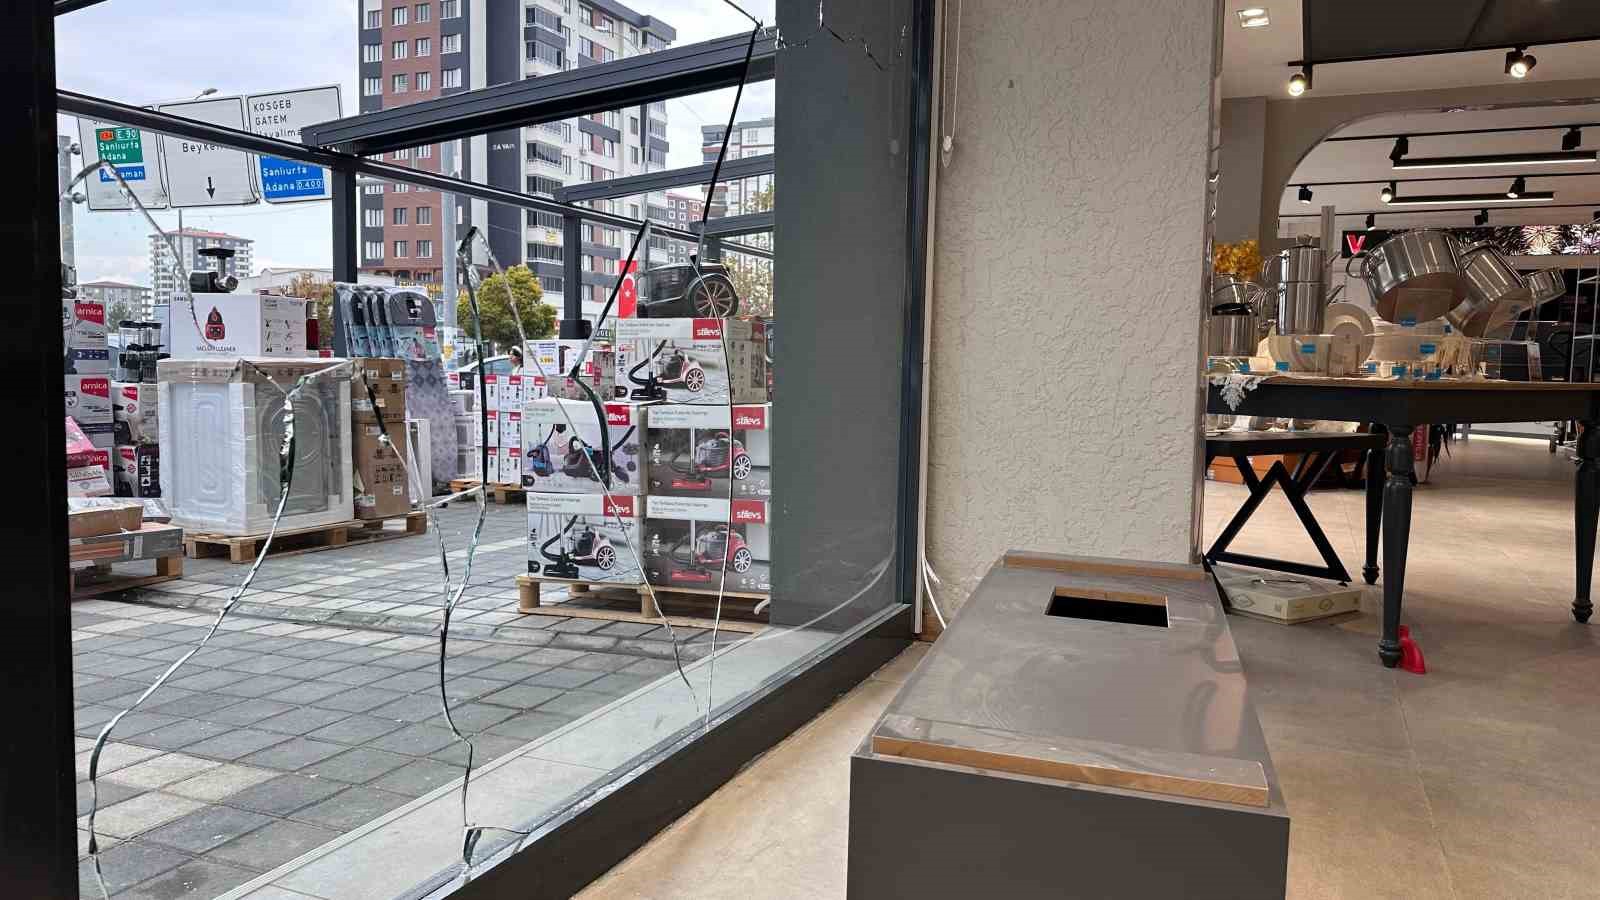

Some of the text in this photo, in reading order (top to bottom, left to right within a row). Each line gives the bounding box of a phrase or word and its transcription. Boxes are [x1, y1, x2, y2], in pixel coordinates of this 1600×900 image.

[253, 100, 291, 112] KOSGEB
[255, 115, 287, 125] GATEM
[265, 182, 295, 192] Adana
[77, 308, 103, 316] arnica
[82, 383, 108, 391] arnica
